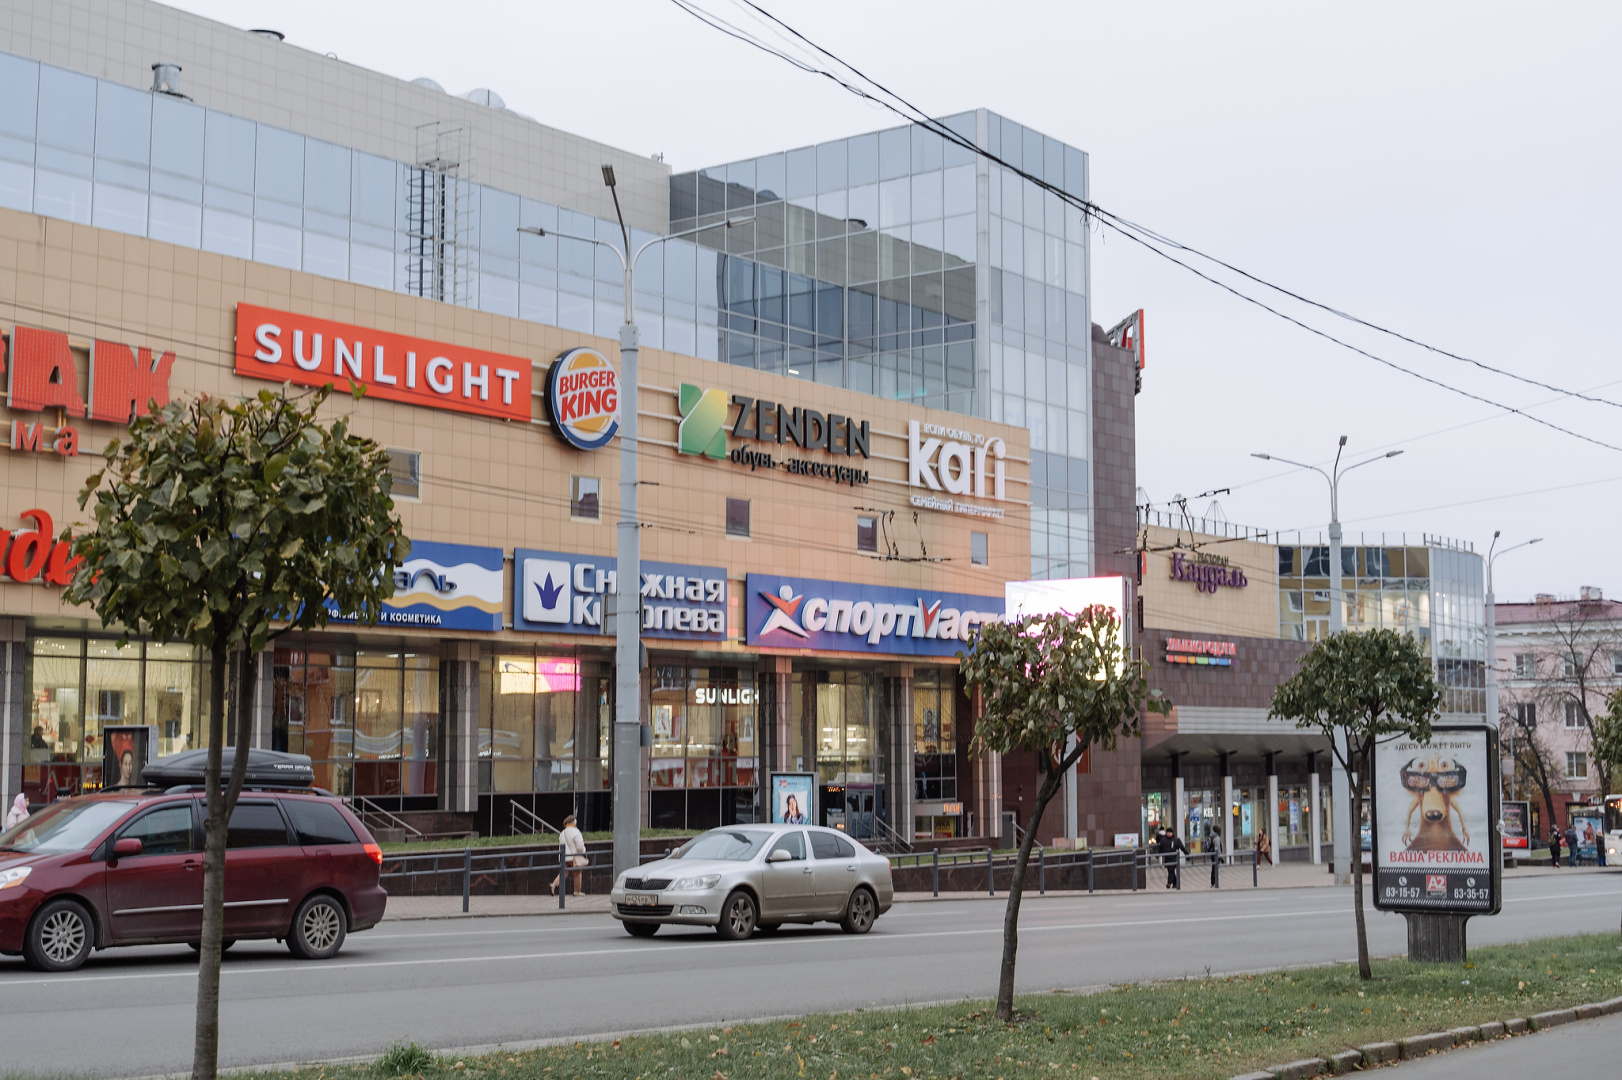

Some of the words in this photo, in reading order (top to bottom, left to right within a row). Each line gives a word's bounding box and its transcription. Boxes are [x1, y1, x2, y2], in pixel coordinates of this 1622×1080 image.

[254, 323, 520, 405] SUNLIGHT
[560, 370, 615, 396] BURGER
[561, 388, 617, 423] KING
[732, 395, 870, 459] ZENDEN
[731, 444, 776, 472] обувь
[787, 457, 869, 487] аксессуары
[909, 420, 1006, 501] kari
[1171, 552, 1248, 594] Каудаль
[1197, 552, 1229, 567] РЕСТОРАН
[573, 563, 725, 602] Снжная
[381, 611, 387, 622] И
[390, 612, 442, 625] КОСМЕТИКА
[573, 595, 725, 633] Колева
[695, 688, 760, 704] SUNLIGH
[1420, 741, 1448, 750] МОЖЕТ
[1389, 851, 1425, 863] ВАША
[1428, 851, 1485, 863] РЕКЛАМА
[1427, 877, 1446, 889] A2
